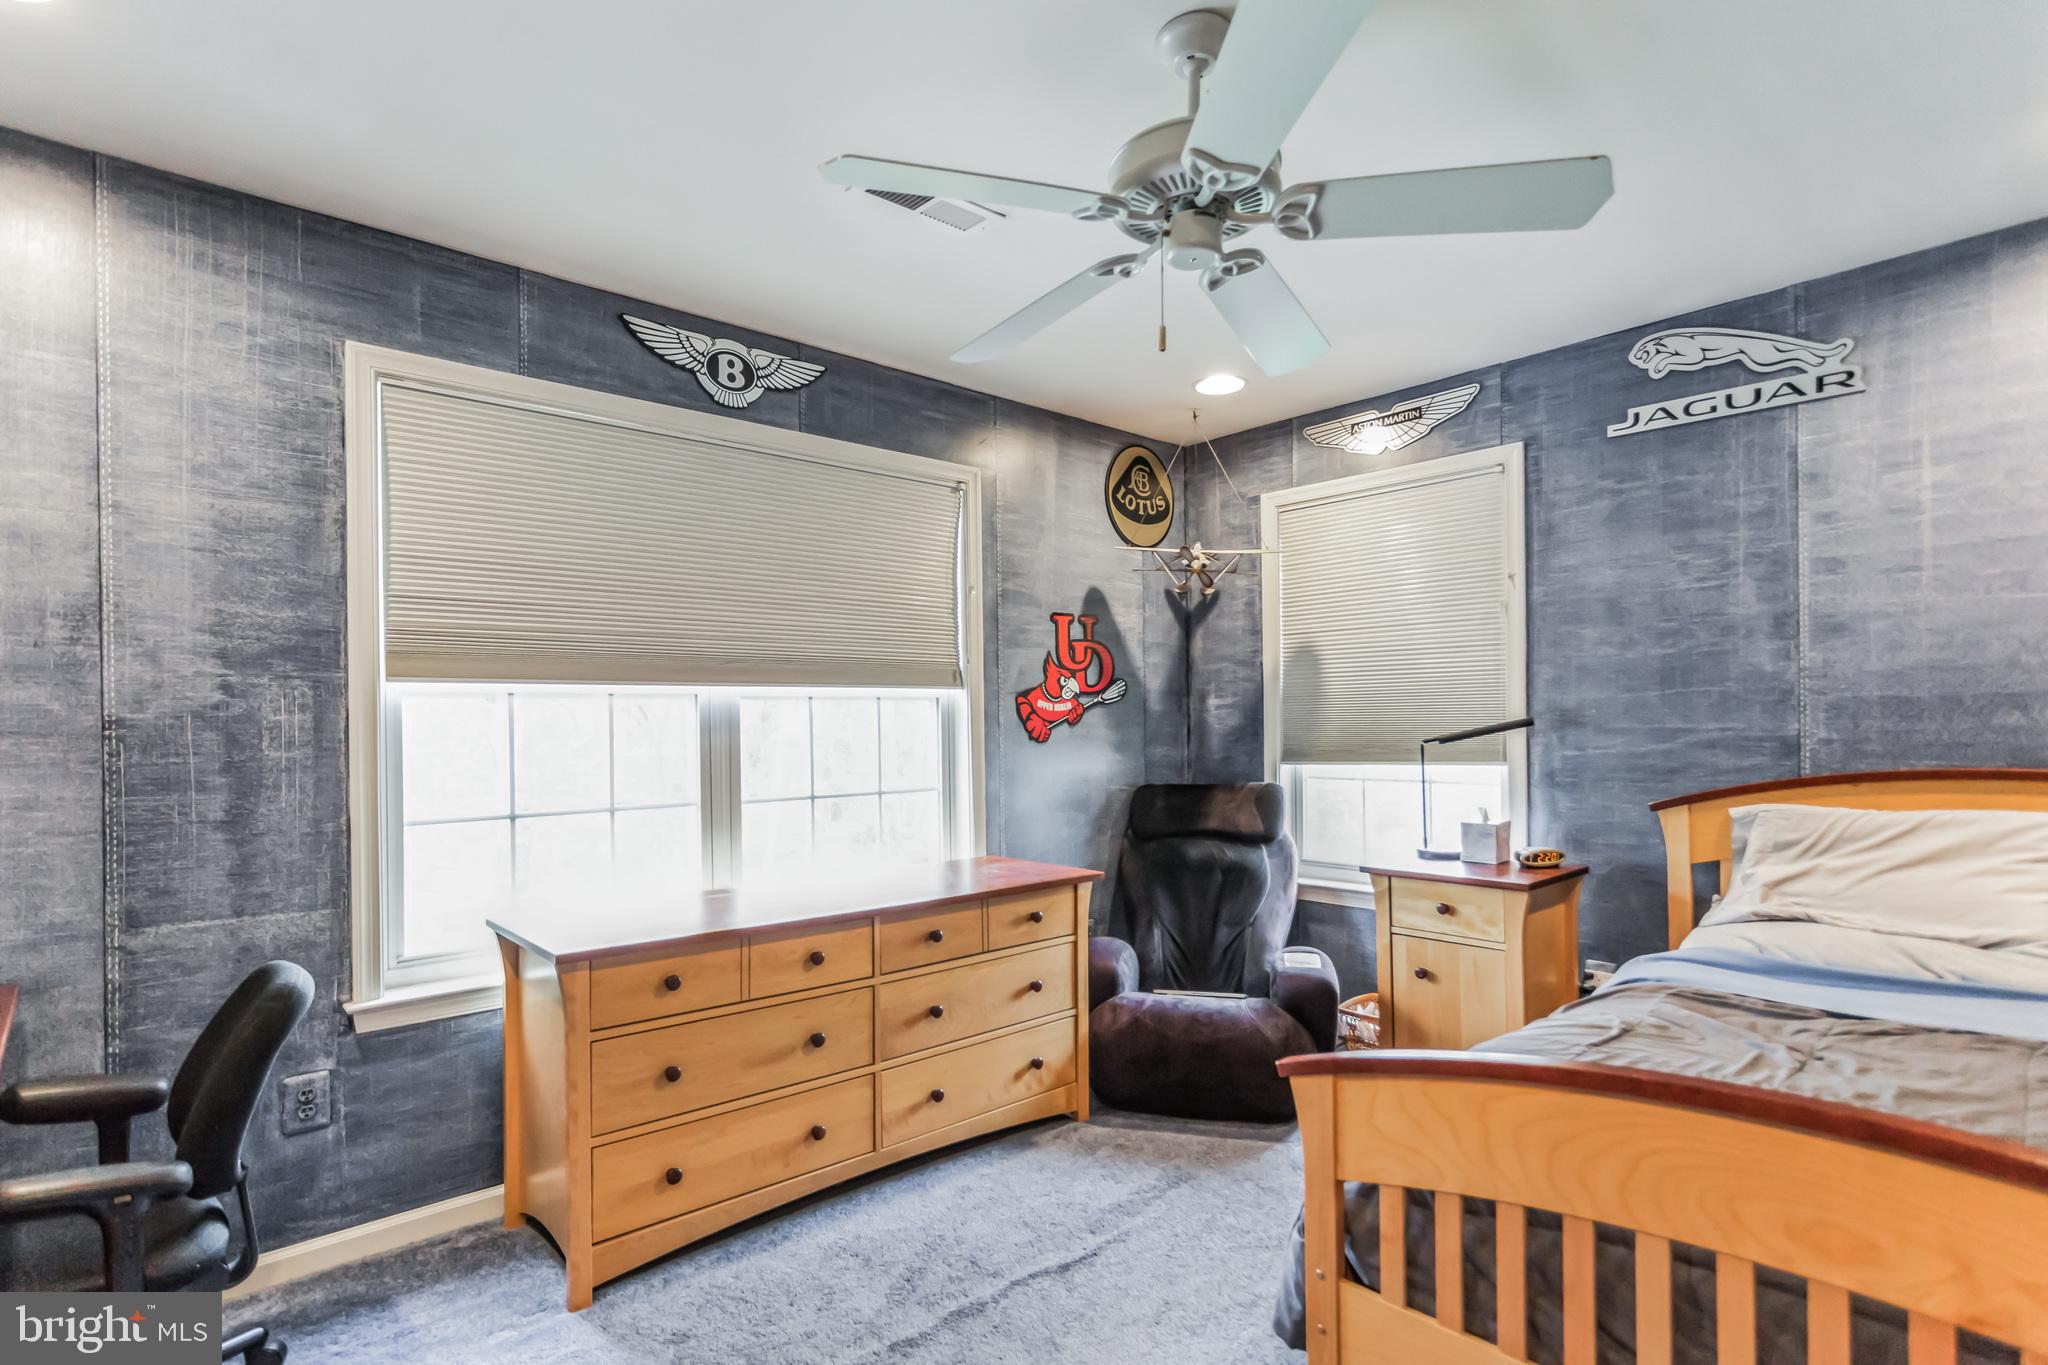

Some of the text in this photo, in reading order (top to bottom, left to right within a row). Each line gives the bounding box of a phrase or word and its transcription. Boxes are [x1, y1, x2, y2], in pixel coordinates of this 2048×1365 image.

[718, 354, 746, 389] B
[1612, 370, 1855, 432] JAGUAR
[1352, 409, 1420, 434] ASTON MARTIN
[1116, 486, 1166, 515] LOTUS
